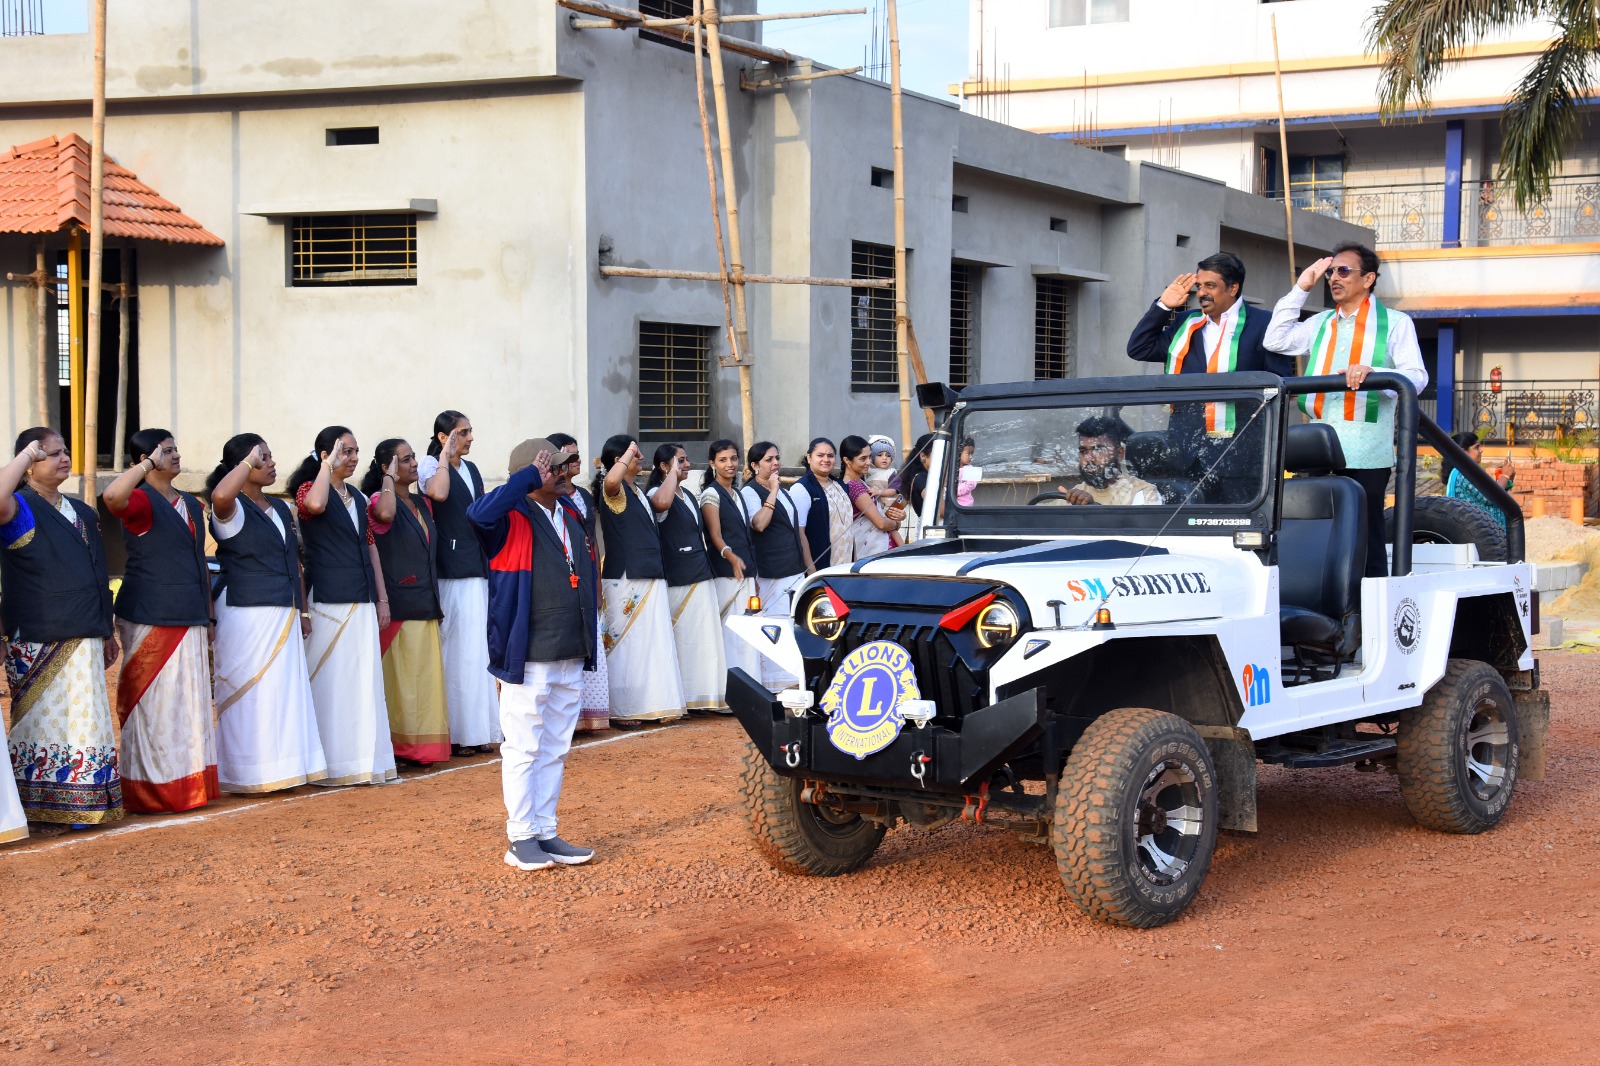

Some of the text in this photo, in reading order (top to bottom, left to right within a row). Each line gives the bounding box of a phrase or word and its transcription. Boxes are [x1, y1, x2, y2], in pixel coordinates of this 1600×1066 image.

[1067, 572, 1211, 601] SM SERVICE
[848, 645, 904, 671] LIONS
[856, 677, 883, 716] L
[836, 728, 892, 749] INTERNATIONAL
[1129, 862, 1189, 903] MAXXIS
